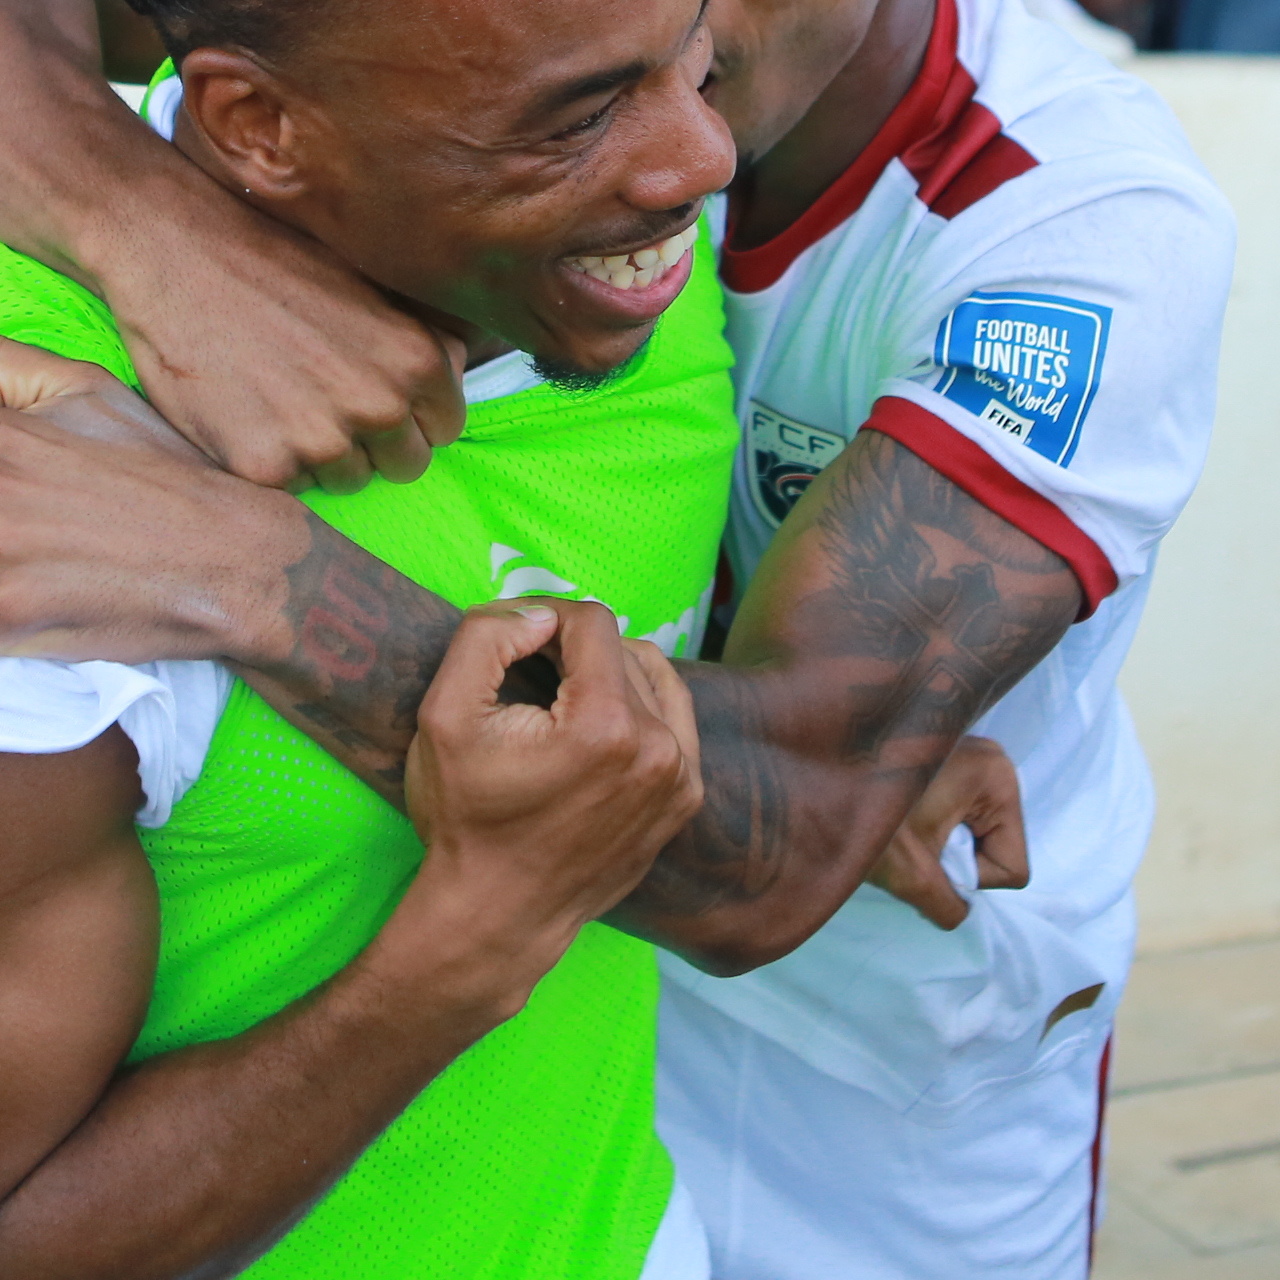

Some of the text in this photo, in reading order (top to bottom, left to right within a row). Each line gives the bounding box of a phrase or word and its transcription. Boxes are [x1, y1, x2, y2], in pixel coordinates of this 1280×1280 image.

[975, 319, 1071, 354] FOOTBALL
[973, 341, 1069, 389] UNITES
[1007, 377, 1069, 423] World
[752, 411, 835, 453] FCF
[987, 408, 1023, 437] FIFA
